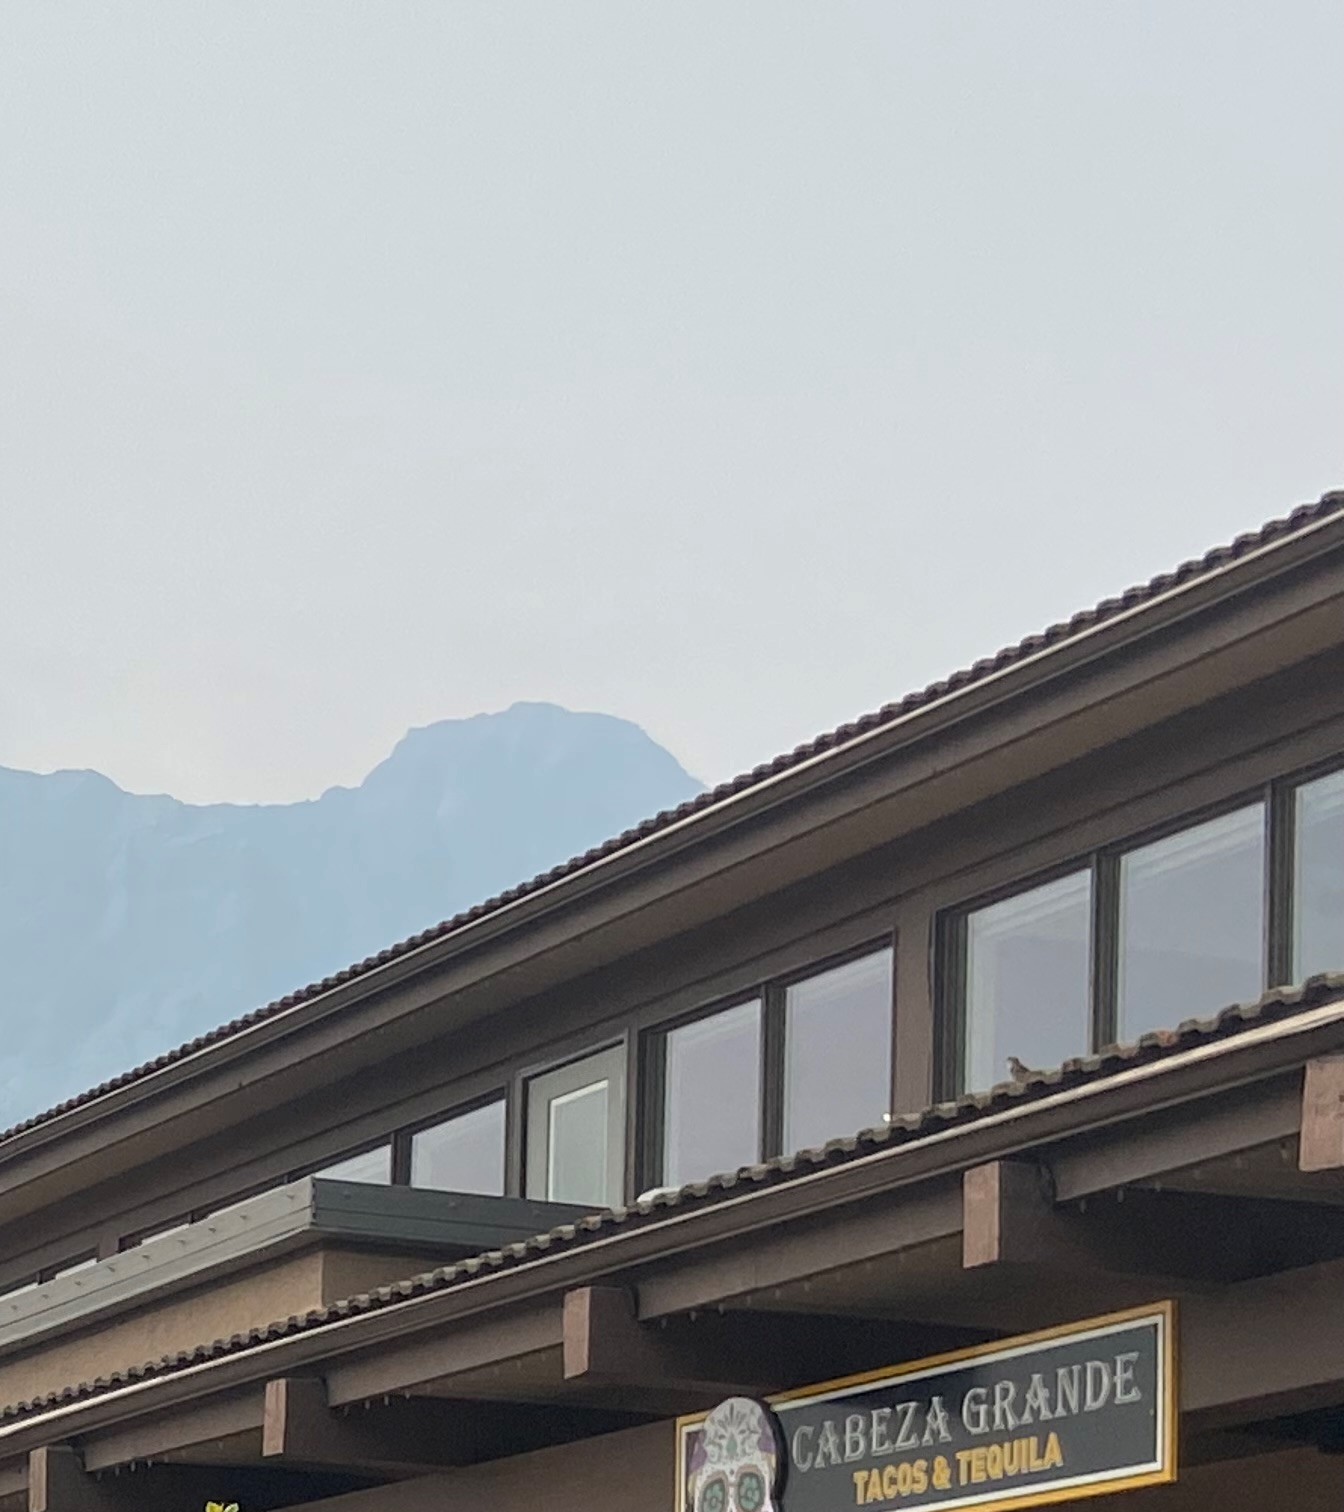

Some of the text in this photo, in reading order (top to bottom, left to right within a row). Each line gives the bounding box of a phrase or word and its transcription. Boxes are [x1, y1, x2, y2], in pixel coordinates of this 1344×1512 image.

[791, 1351, 1142, 1473] CABEZA GRANDE
[853, 1431, 1064, 1505] TACOS & TEQUILA
